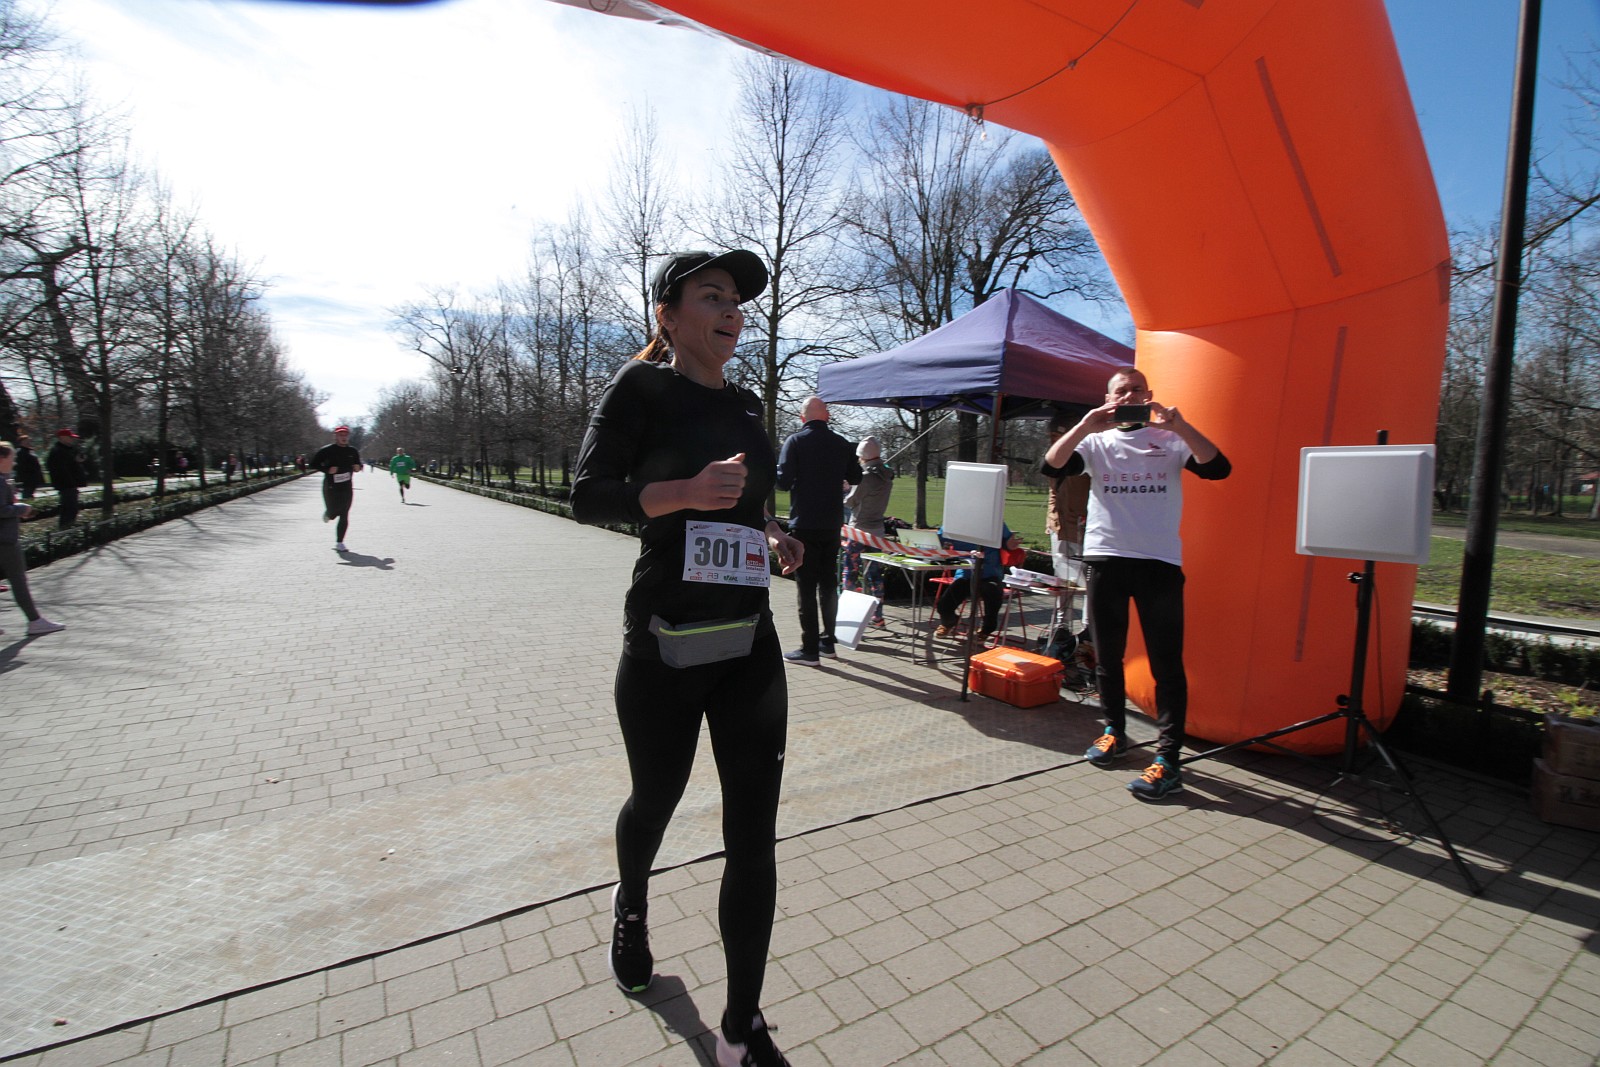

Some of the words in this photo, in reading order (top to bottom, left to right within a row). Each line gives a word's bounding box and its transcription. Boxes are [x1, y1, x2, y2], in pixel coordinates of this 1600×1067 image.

[1103, 472, 1167, 482] BIEGAM
[1103, 485, 1167, 494] POMAGAM
[694, 537, 740, 568] 301
